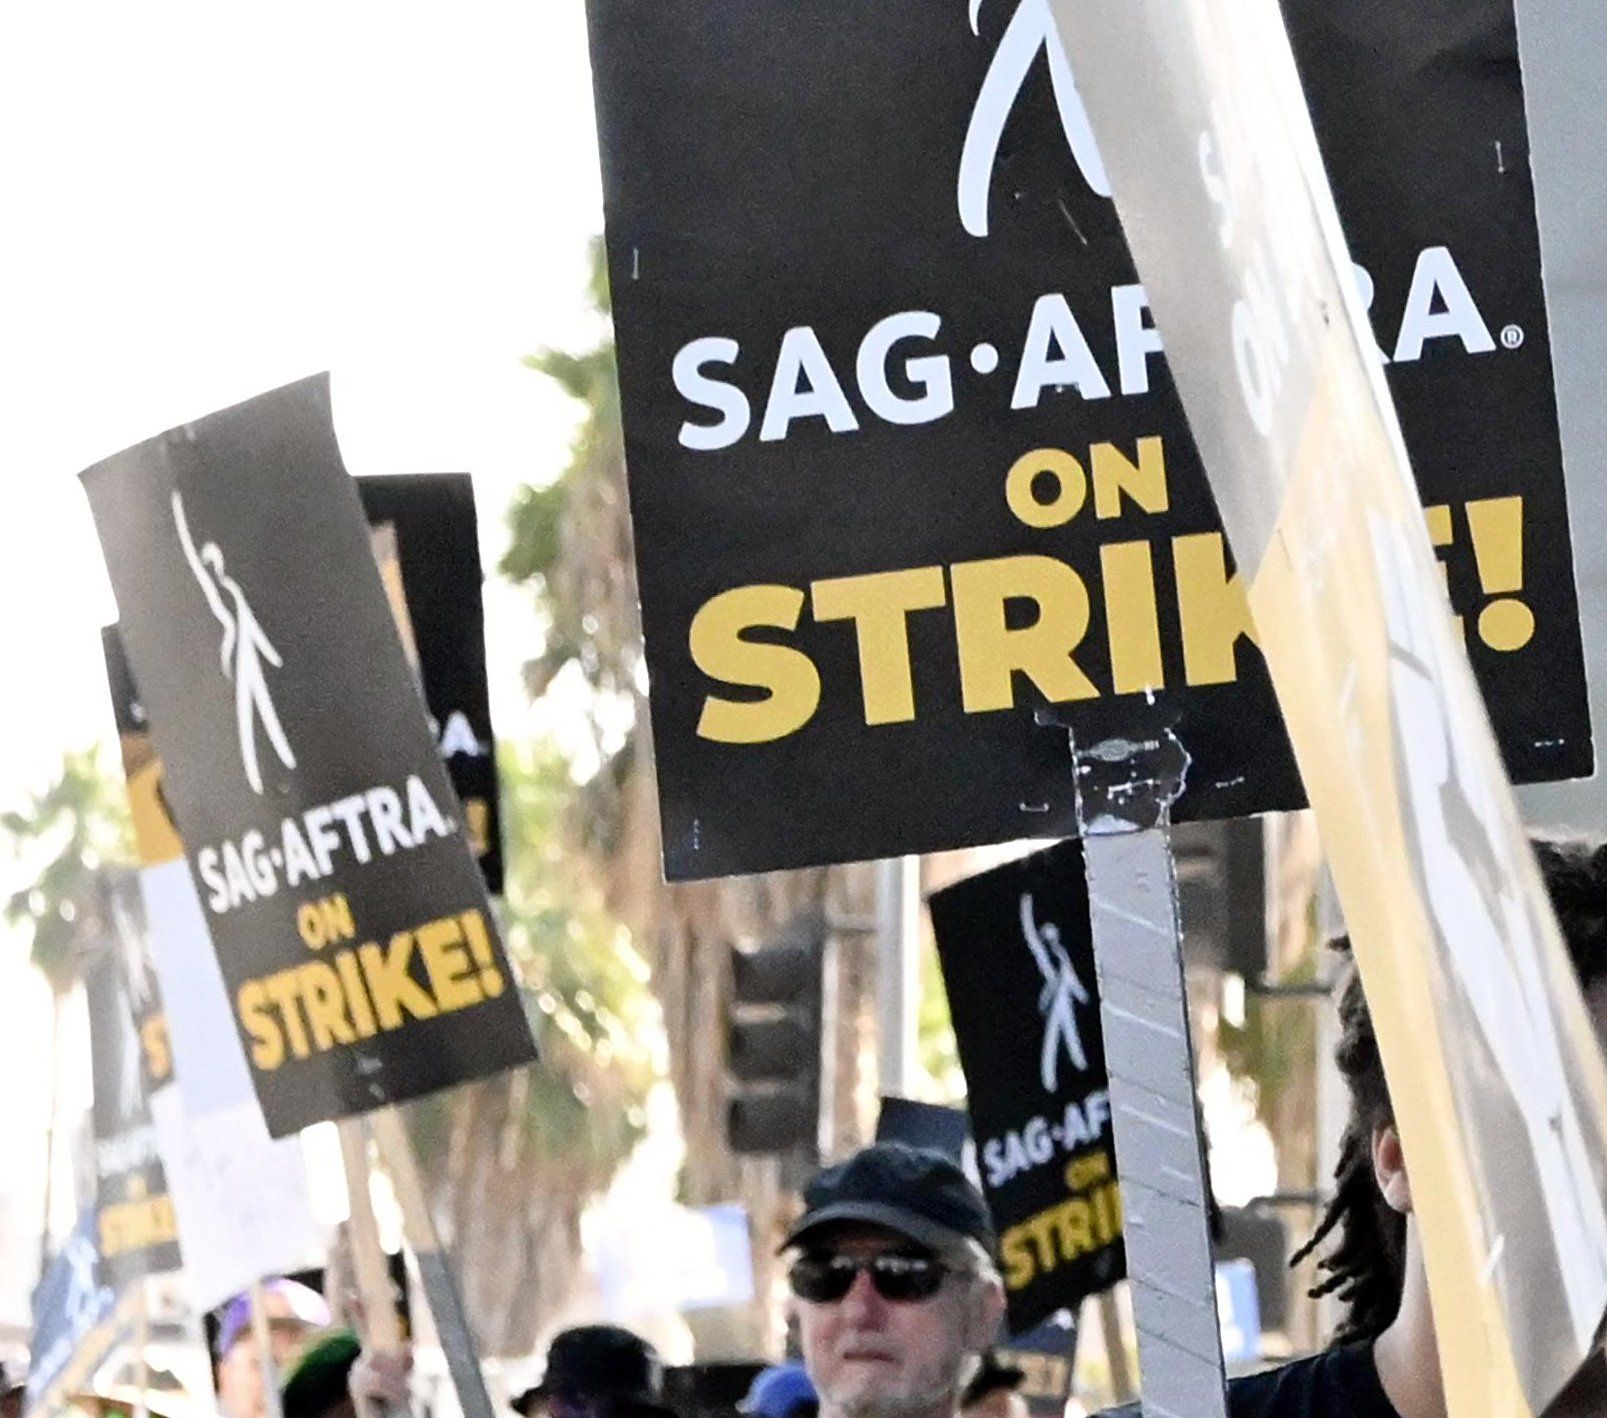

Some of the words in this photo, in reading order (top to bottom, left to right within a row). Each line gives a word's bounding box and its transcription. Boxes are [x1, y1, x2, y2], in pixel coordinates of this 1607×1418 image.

[1005, 435, 1169, 529] ON
[687, 495, 1535, 744] STRIK!
[297, 892, 356, 950] ON
[237, 908, 504, 1071] STRIKE!
